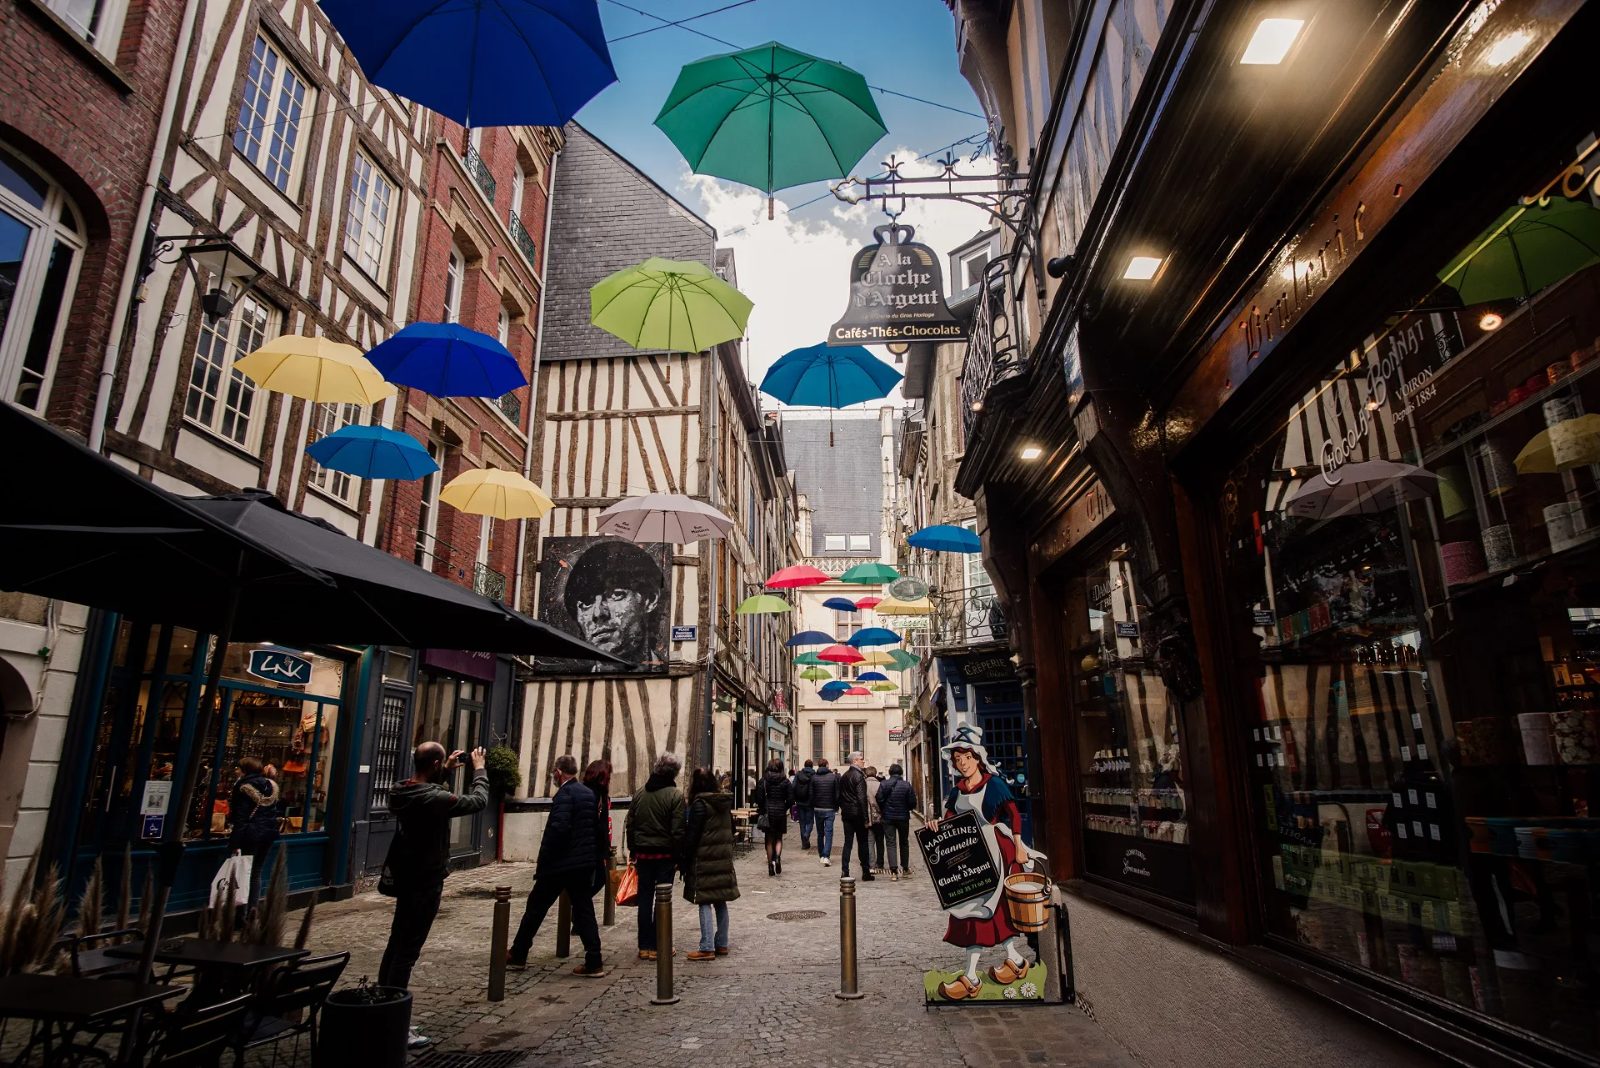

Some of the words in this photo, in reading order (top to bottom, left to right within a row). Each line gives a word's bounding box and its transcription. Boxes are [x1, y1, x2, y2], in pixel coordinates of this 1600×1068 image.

[878, 253, 891, 267] A
[897, 252, 912, 265] la
[860, 269, 931, 290] Cloche
[855, 290, 939, 309] d'Argent
[835, 324, 961, 339] Cafés-Thés-Chocolats
[1395, 365, 1433, 400] VOIRON
[1392, 404, 1415, 425] Depuis
[1415, 383, 1437, 407] 1884
[924, 825, 978, 851] MADELEINES
[929, 837, 979, 864] Jeannette
[938, 874, 962, 887] Cloche
[963, 861, 991, 878] d'Argent
